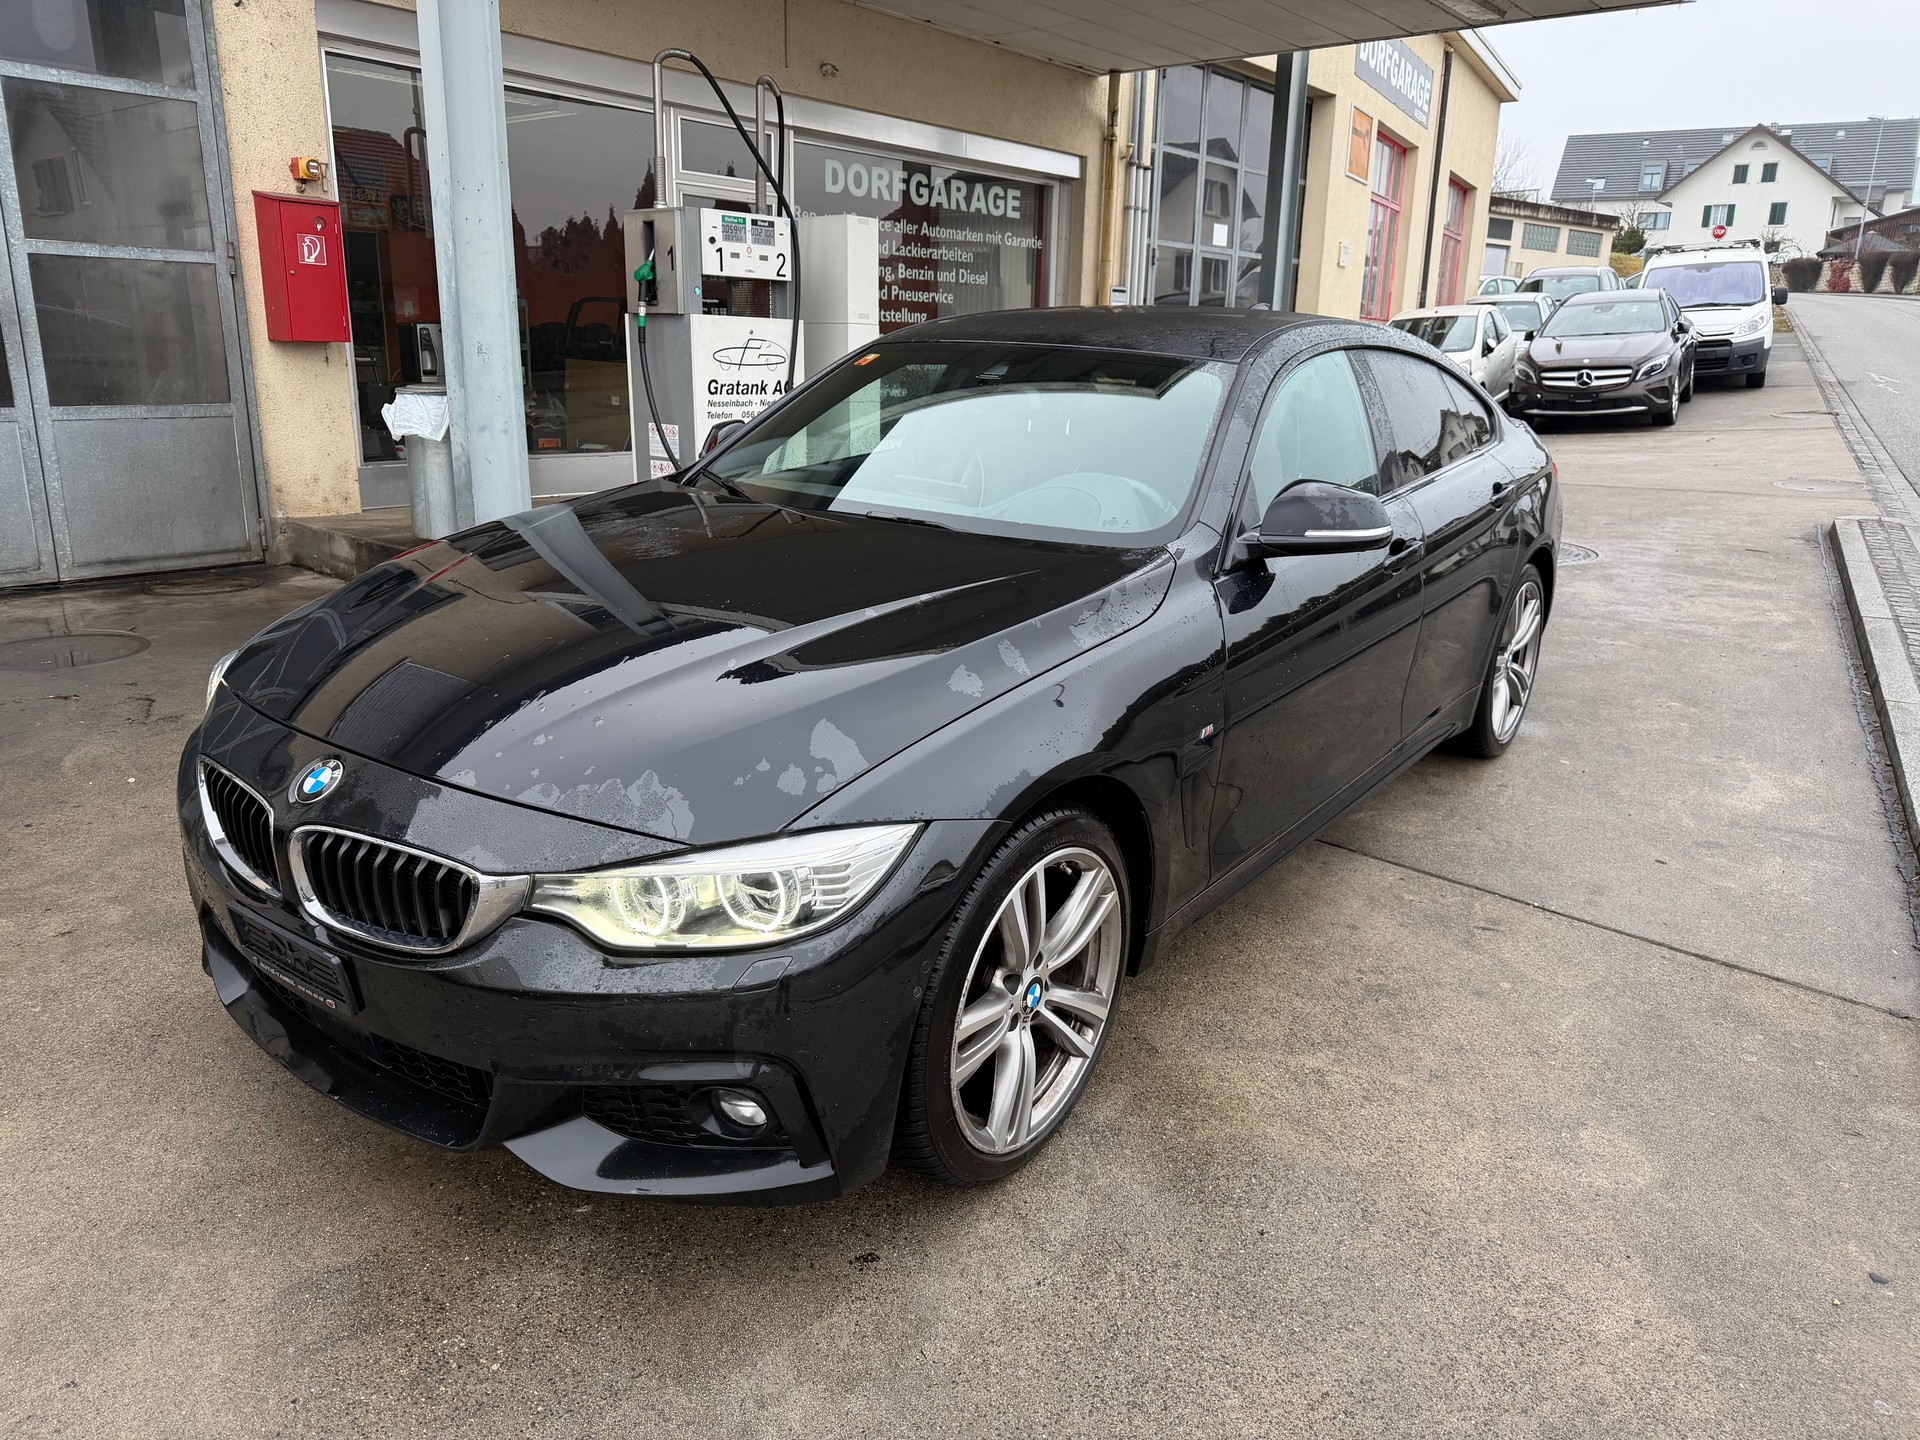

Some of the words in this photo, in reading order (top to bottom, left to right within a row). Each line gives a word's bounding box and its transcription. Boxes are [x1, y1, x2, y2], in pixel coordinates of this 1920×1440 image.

[824, 158, 1021, 219] DORFGARAGE
[894, 218, 918, 235] aller
[920, 221, 983, 243] Automarken
[986, 230, 1002, 245] mit
[1004, 232, 1043, 249] Garantie
[667, 245, 674, 271] 1
[715, 247, 723, 272] 1
[892, 240, 974, 263] Lackierarbeiten
[776, 253, 786, 278] 2
[898, 263, 934, 281] Benzin
[937, 268, 956, 283] und
[959, 268, 988, 285] Diesel
[891, 285, 954, 304] Pneuservice
[879, 307, 927, 323] tstellung
[707, 379, 769, 396] Gratank
[707, 399, 753, 408] Nesselnbach
[707, 411, 733, 419] Telefon
[741, 411, 755, 419] 056
